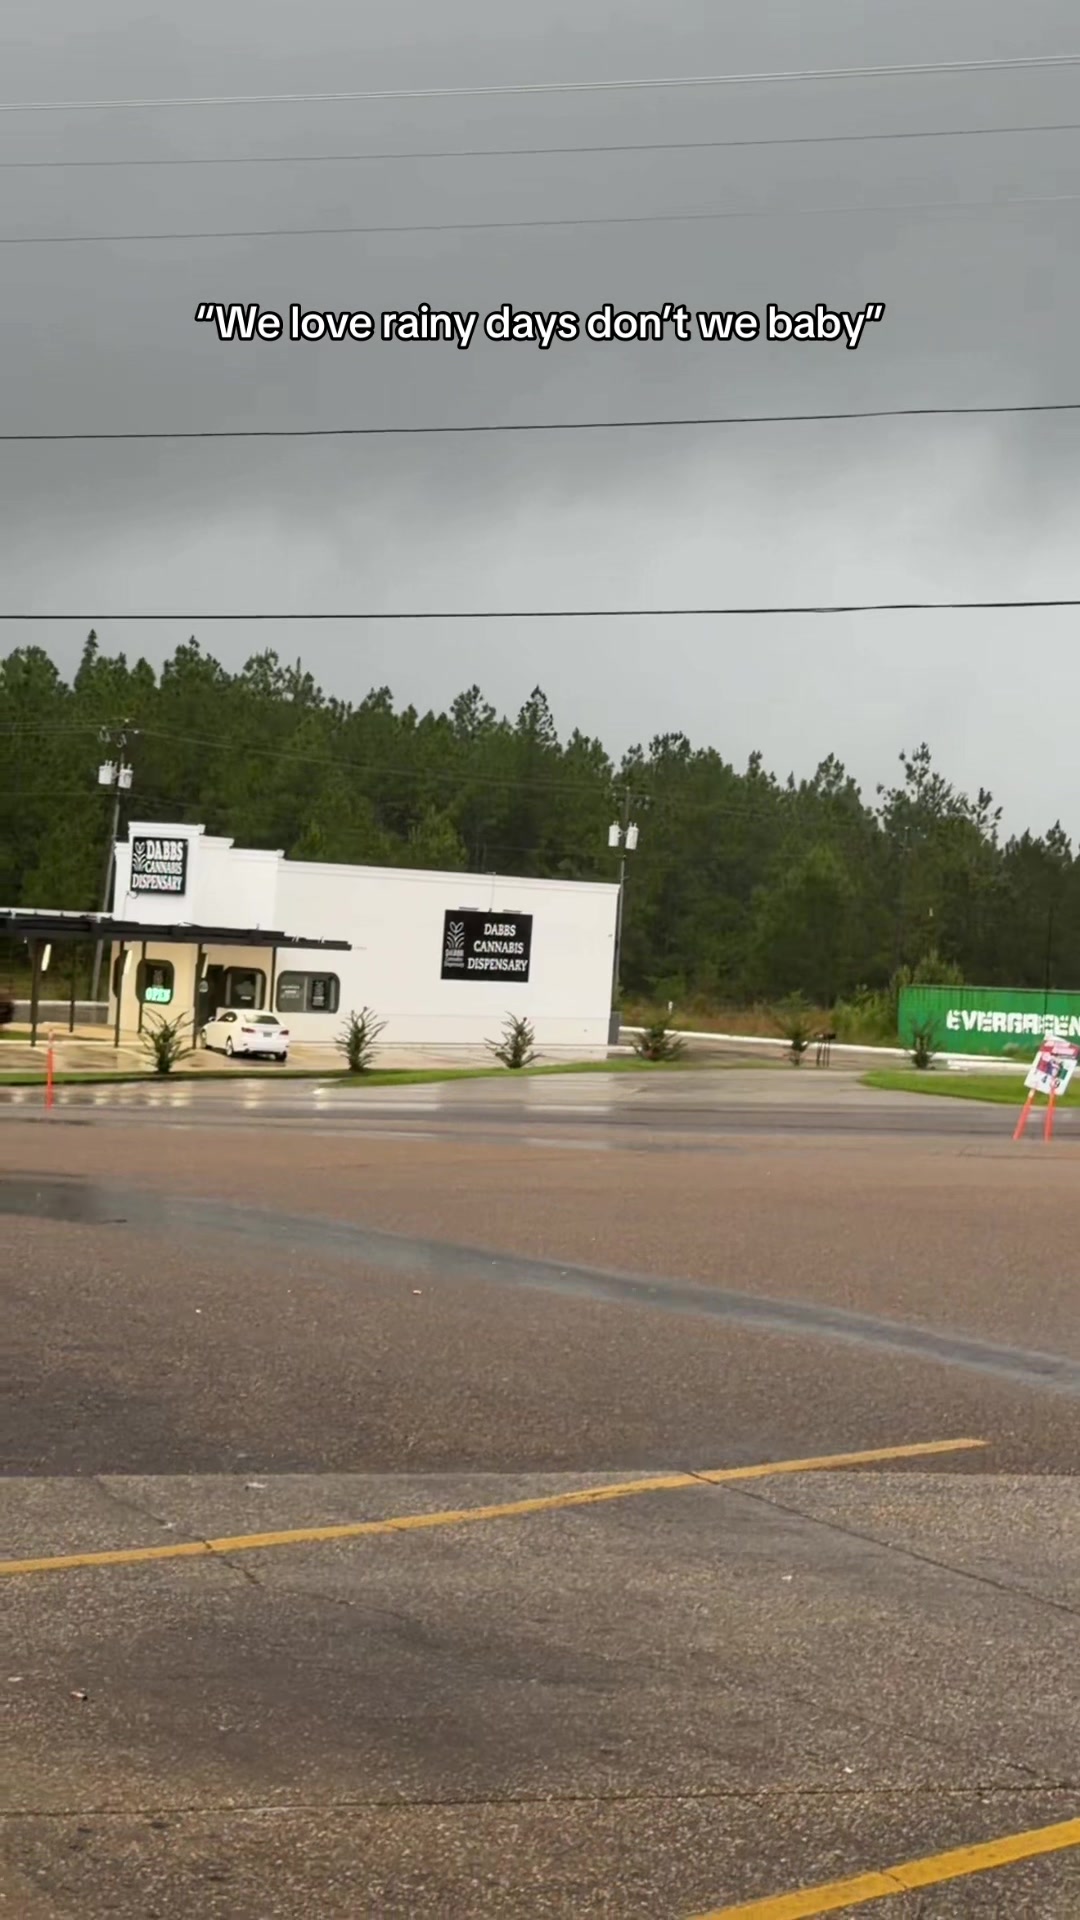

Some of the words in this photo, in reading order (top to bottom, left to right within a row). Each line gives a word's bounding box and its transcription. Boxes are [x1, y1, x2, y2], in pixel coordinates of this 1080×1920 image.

[146, 840, 183, 861] DABBS
[132, 874, 182, 890] DISPENSARY
[484, 923, 516, 936] DABBS
[473, 940, 524, 954] CANNABIS
[467, 957, 528, 971] DISPENSARY
